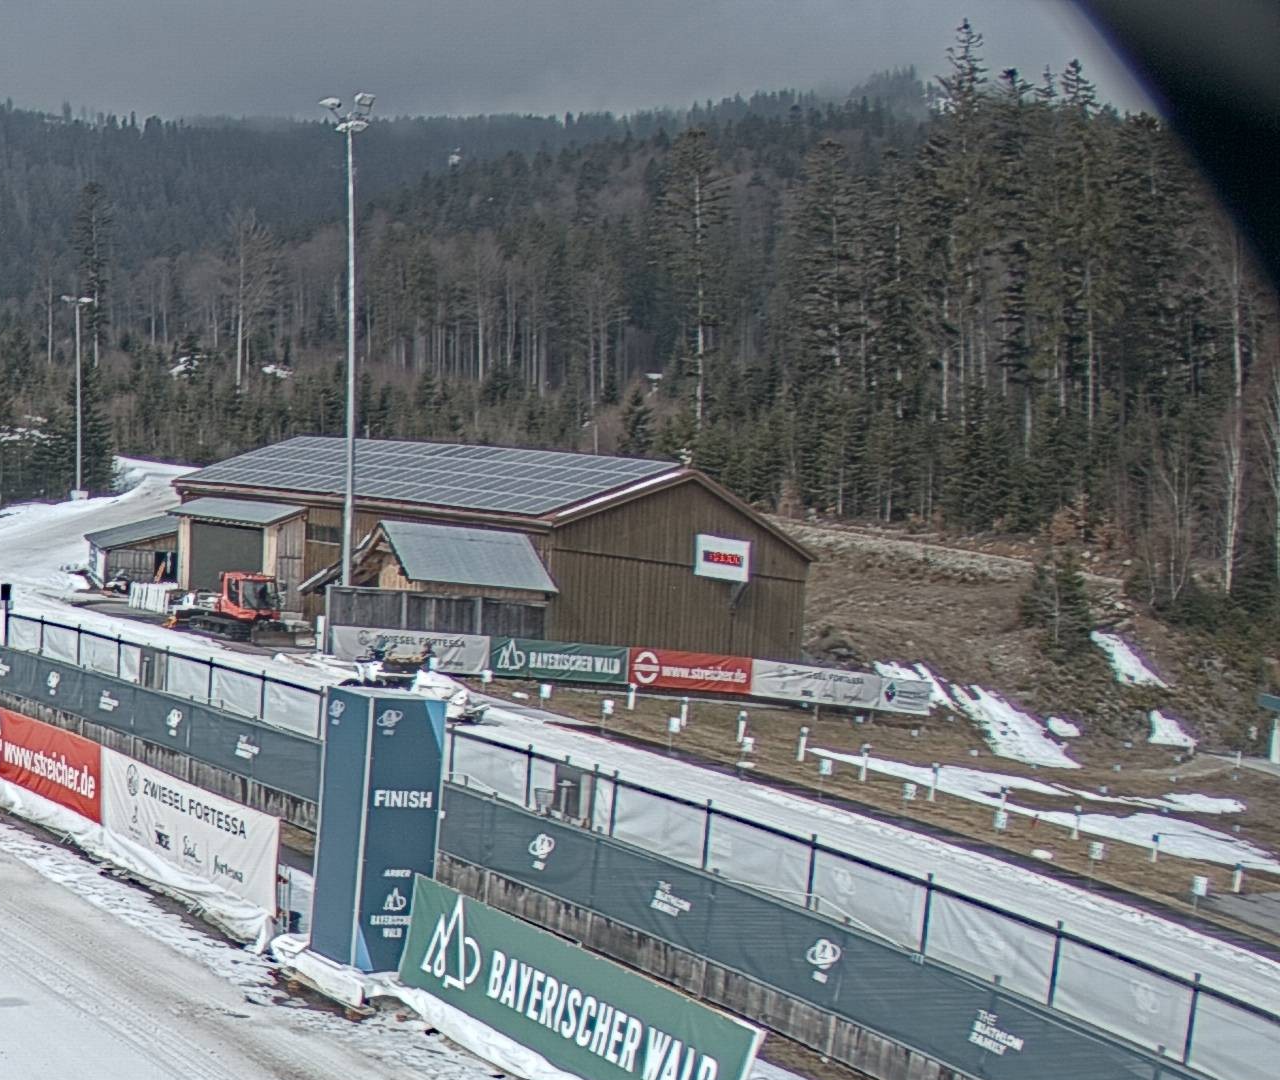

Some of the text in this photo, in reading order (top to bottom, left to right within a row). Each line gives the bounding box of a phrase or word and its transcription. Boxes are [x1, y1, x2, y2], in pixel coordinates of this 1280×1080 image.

[594, 656, 620, 674] WALD
[4, 741, 96, 799] www.streicher.de
[142, 778, 187, 812] ZWIESEL
[188, 798, 247, 840] FORTESSA
[374, 790, 433, 809] FINISH
[486, 950, 644, 1073] BAYERISCHER
[976, 1009, 1000, 1026] THE
[973, 1020, 1025, 1051] BIATHLON
